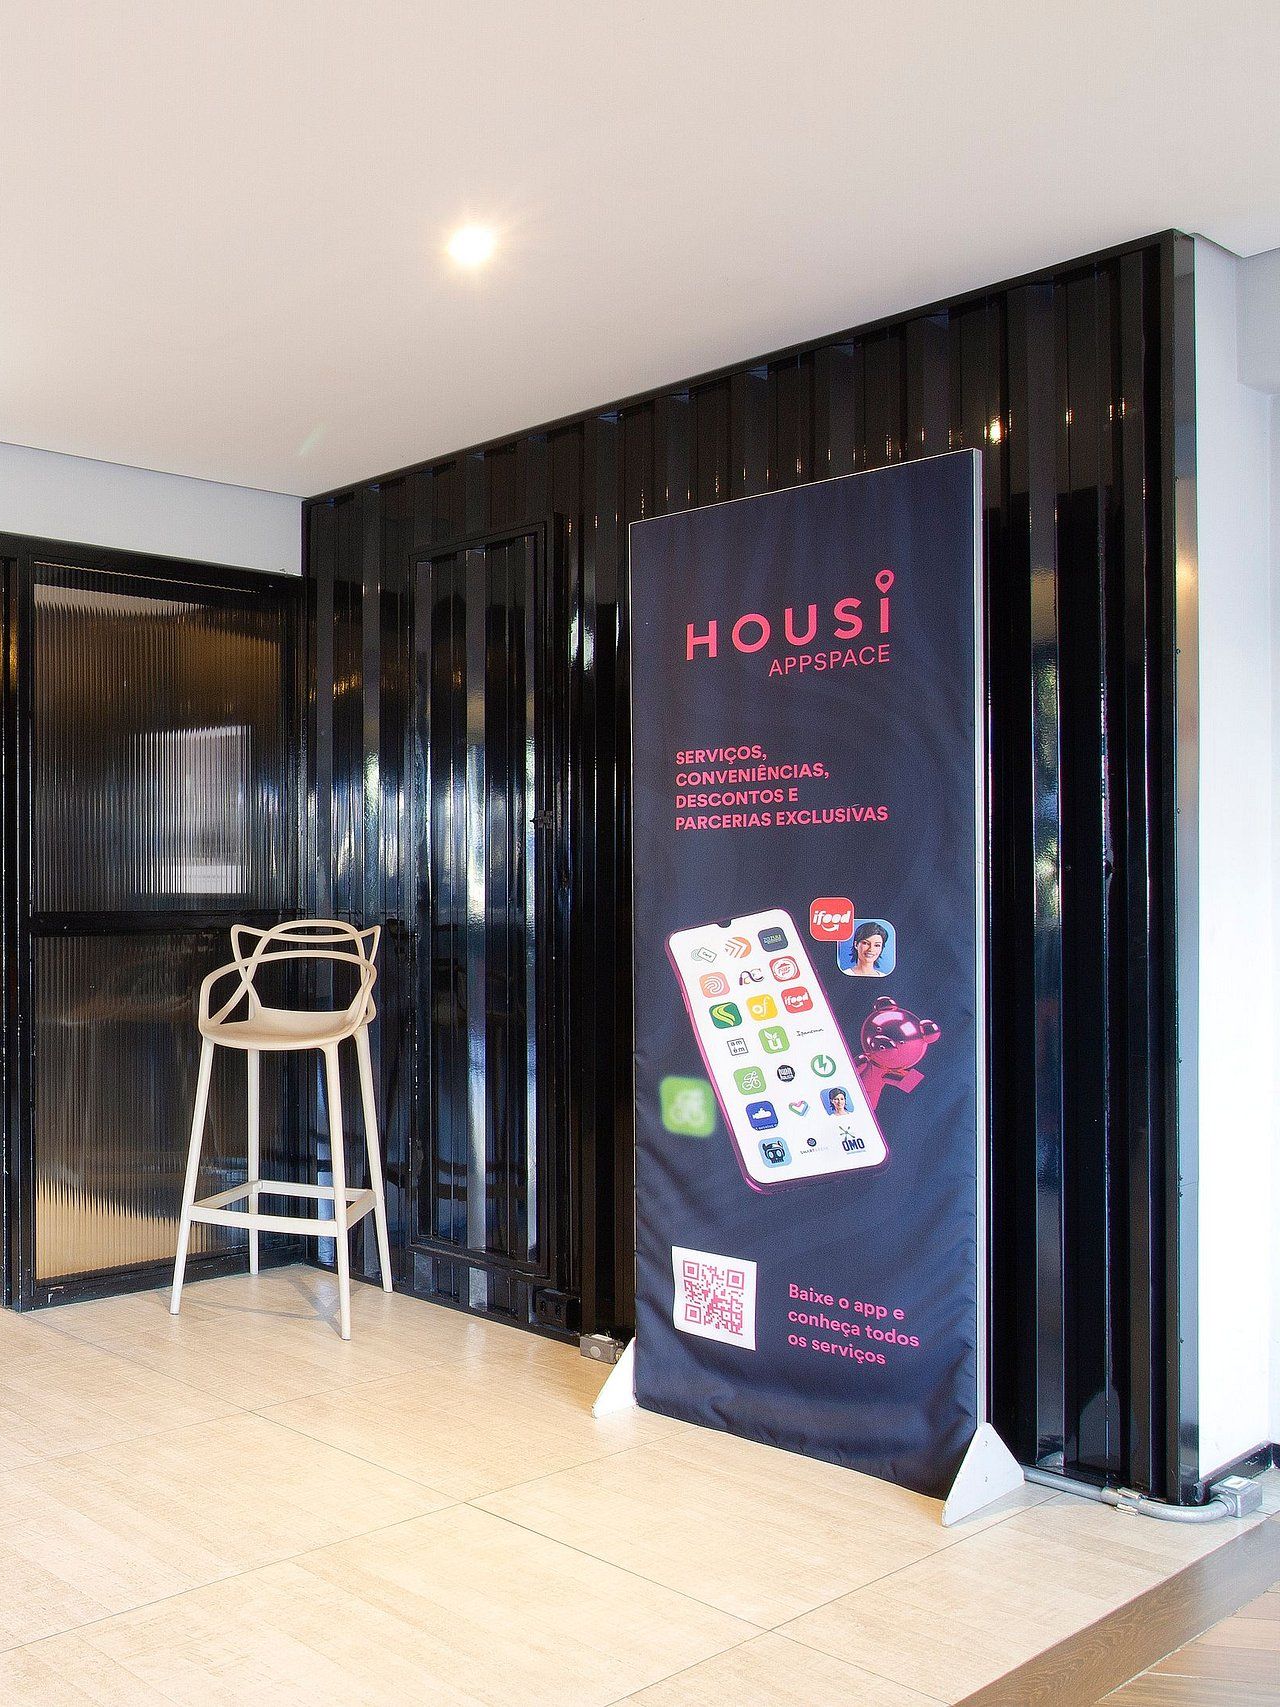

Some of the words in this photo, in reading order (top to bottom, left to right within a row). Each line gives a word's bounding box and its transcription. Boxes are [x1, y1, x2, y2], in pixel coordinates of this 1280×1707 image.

[768, 644, 891, 677] APPSPACE
[675, 745, 768, 766] SERVIÇOS,
[675, 763, 830, 787] CONVENIÊNCIAS,
[675, 789, 784, 808] DESCONTOS
[788, 788, 798, 802] E
[675, 812, 771, 831] PARCERIAS
[776, 805, 889, 827] EXCLUSIVAS
[813, 910, 851, 926] ifood
[789, 1283, 834, 1306] Baixe
[839, 1298, 850, 1310] o
[854, 1301, 888, 1320] app
[893, 1308, 905, 1320] e
[788, 1311, 860, 1337] conheça
[865, 1324, 919, 1347] todos
[788, 1333, 807, 1348] os
[811, 1339, 886, 1365] serviços
